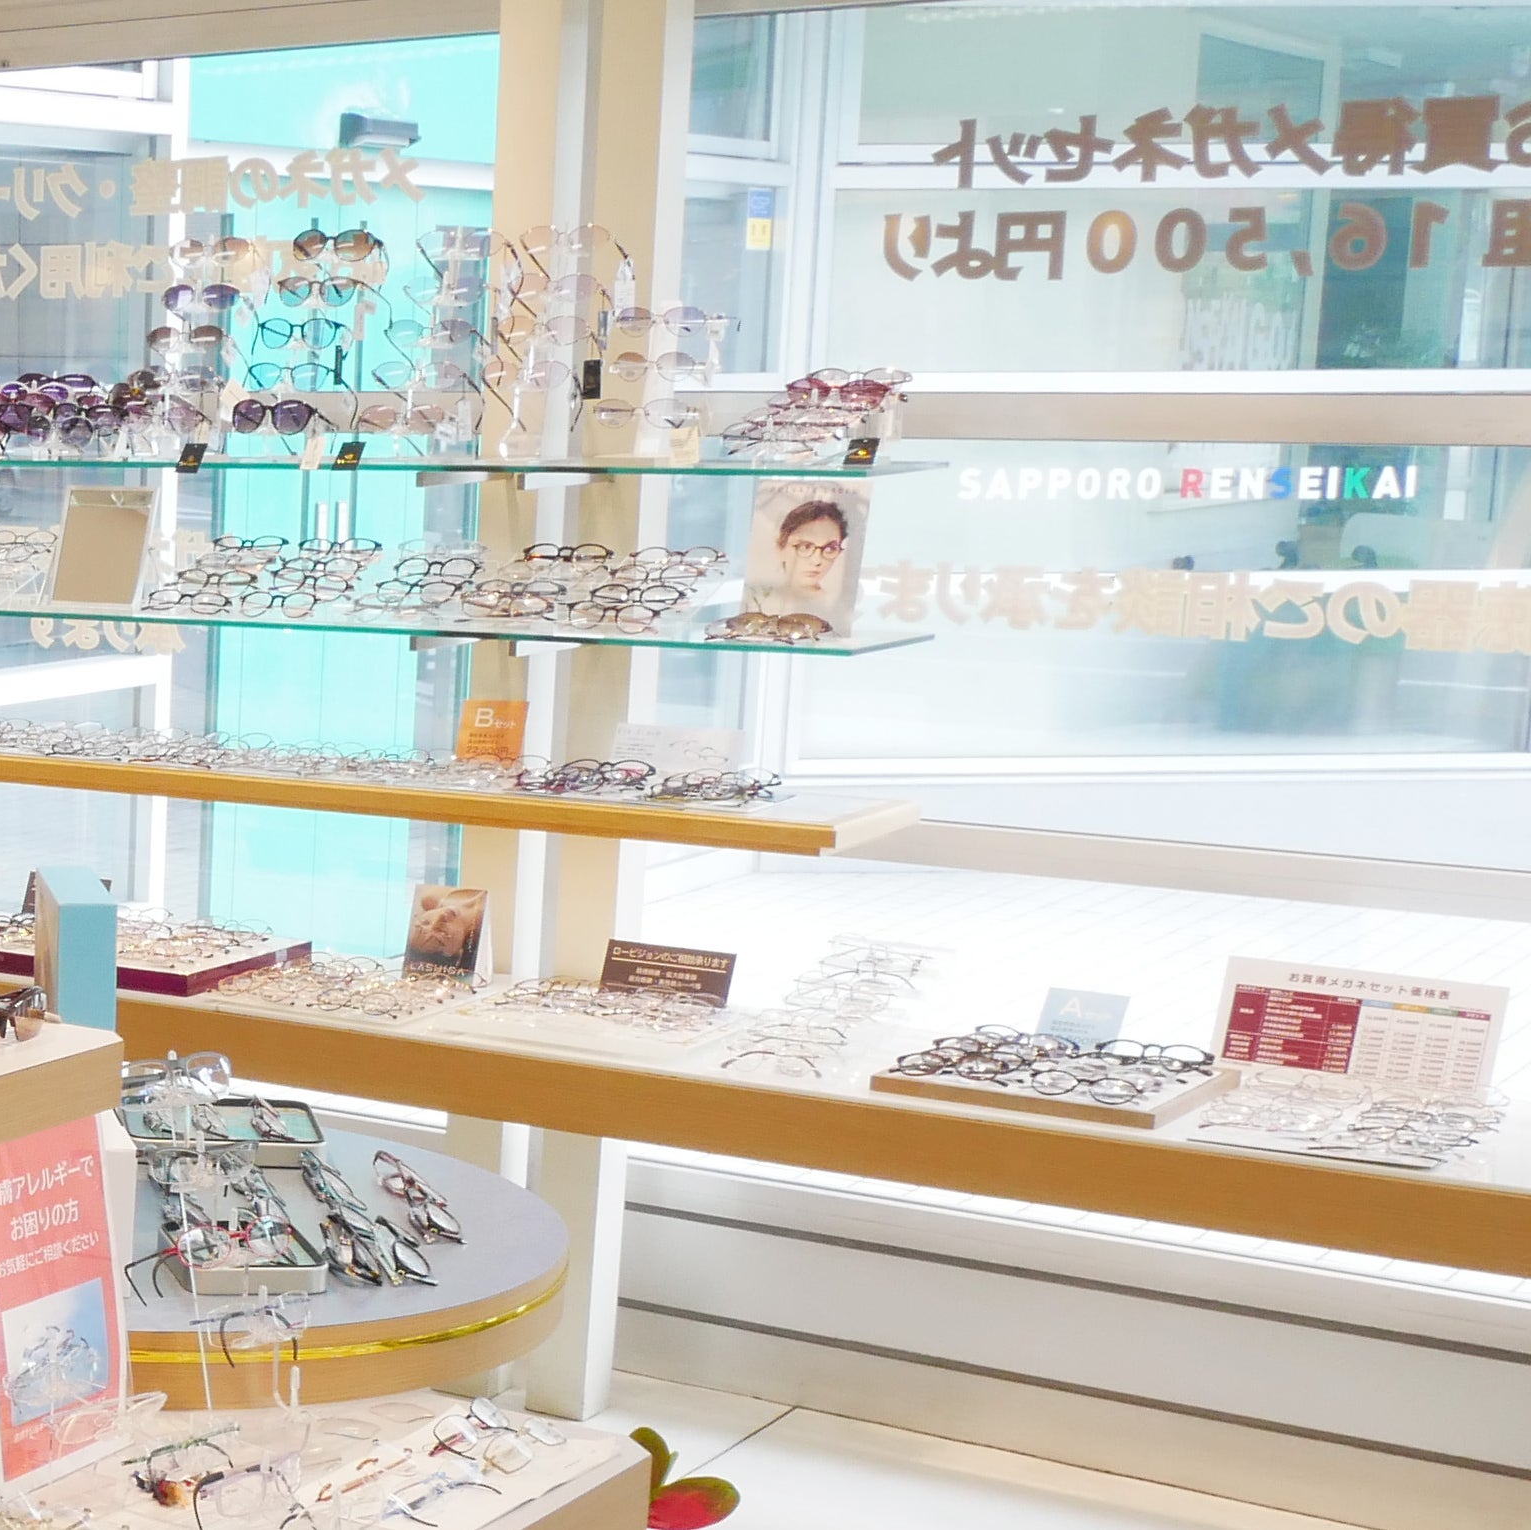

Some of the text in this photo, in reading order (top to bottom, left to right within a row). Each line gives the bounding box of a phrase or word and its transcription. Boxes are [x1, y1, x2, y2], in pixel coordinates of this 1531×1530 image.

[957, 465, 1419, 500] SAPPORO RENSEIKAI
[9, 1198, 79, 1241] お困りの方
